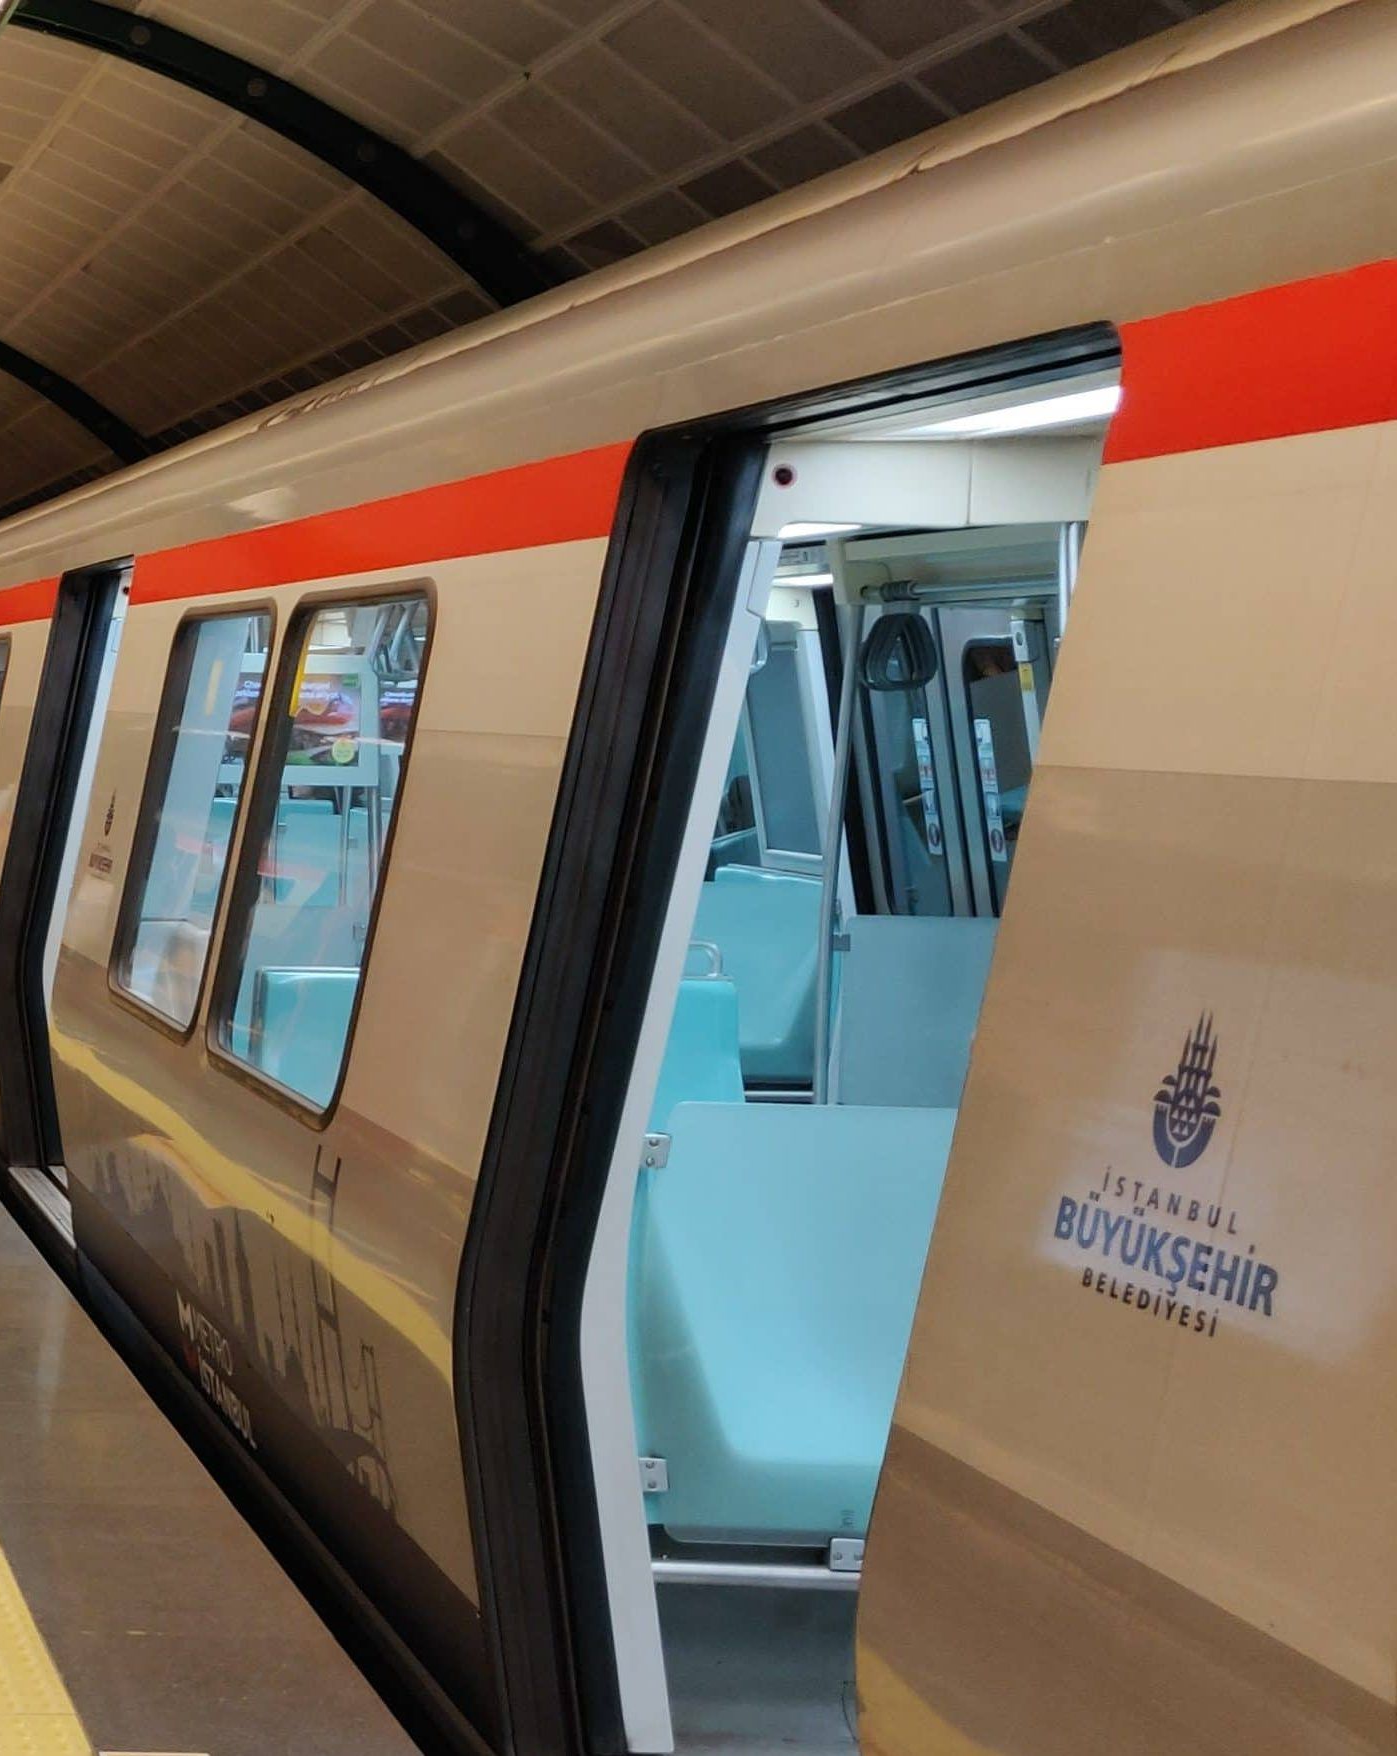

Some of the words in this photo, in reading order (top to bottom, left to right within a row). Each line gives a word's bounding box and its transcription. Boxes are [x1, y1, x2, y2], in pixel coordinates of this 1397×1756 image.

[1102, 1166, 1237, 1235] İSTANBUL
[1054, 1190, 1278, 1317] BÜYÜKŞEHİR
[1081, 1266, 1220, 1338] BELEDİYESİ
